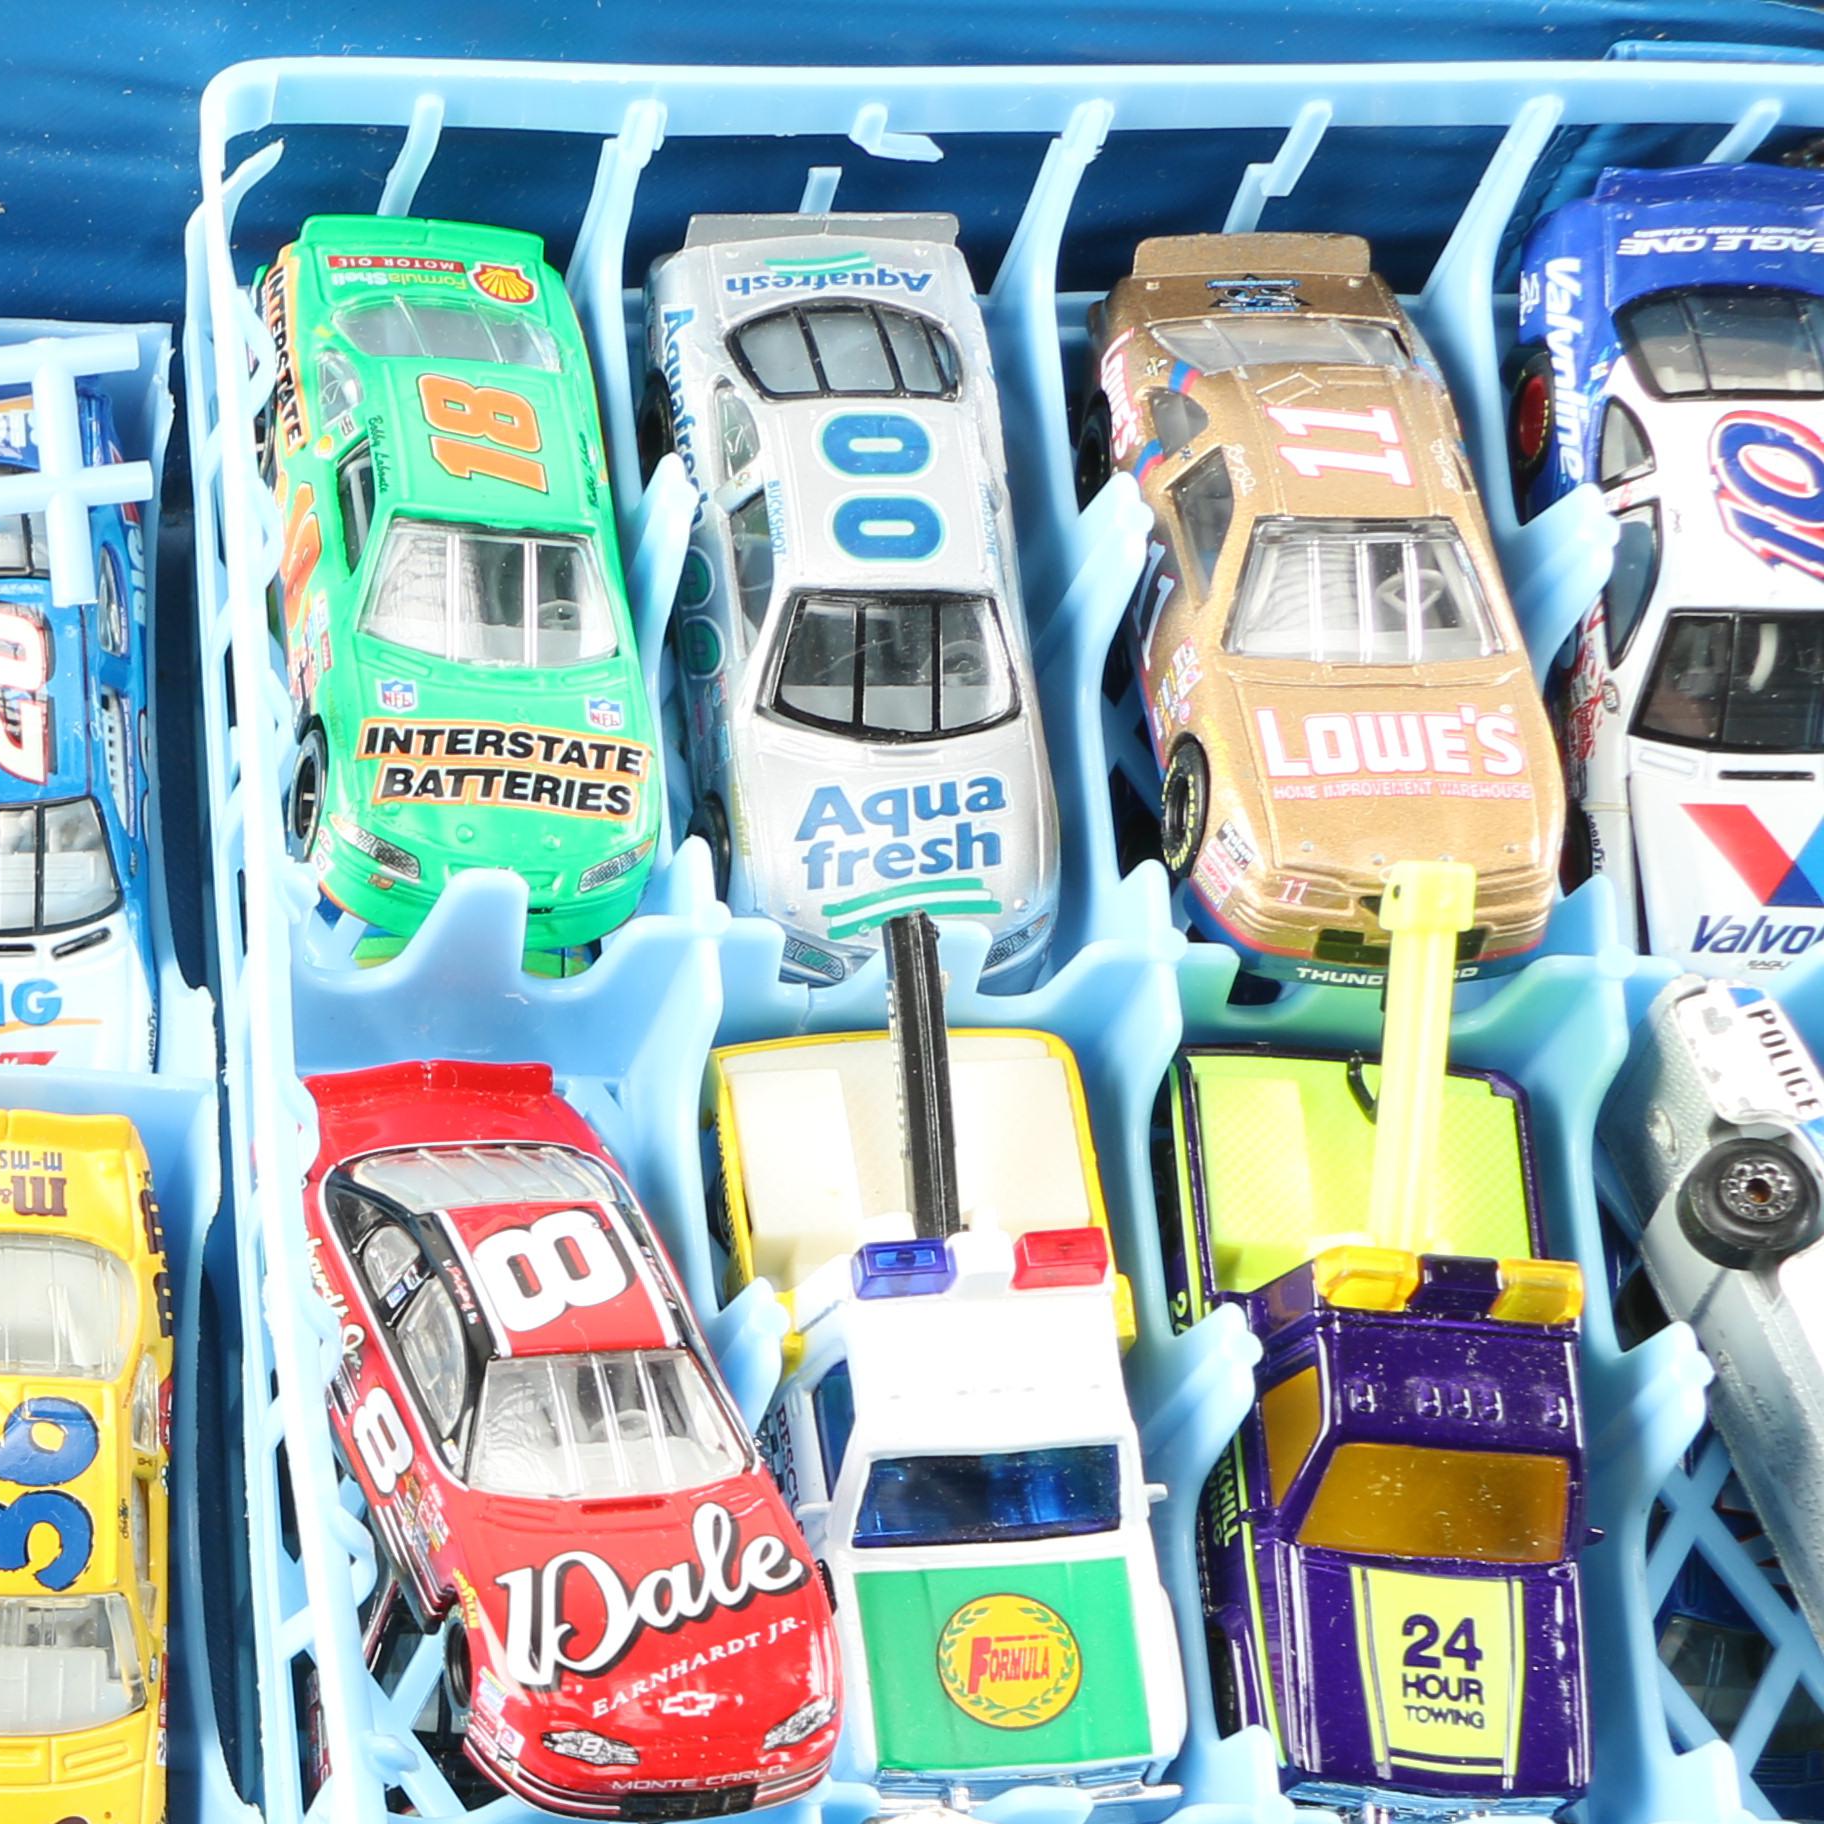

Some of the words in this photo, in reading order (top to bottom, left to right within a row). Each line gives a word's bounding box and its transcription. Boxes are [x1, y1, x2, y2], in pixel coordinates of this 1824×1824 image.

[336, 255, 372, 269] OIL
[381, 256, 456, 271] MOTOR
[1615, 236, 1710, 256] ONE
[725, 267, 935, 298] Aquafresh
[415, 372, 551, 496] 18
[1263, 402, 1415, 488] 11
[815, 408, 947, 564] 00
[767, 479, 787, 556] BUCKSHOT
[382, 690, 414, 707] NFL
[589, 709, 621, 727] NFL
[363, 726, 644, 778] INTERSTATE
[1253, 703, 1525, 779] LOWE'S
[380, 765, 634, 817] BATTERIES
[794, 774, 1007, 843] Aqua
[1272, 783, 1319, 801] HOME
[1322, 779, 1433, 799] IMPROVEMENT
[1438, 779, 1533, 801] WAREHOUSE
[801, 820, 1003, 891] fresh
[1278, 878, 1309, 905] 11
[1691, 914, 1824, 955] Valvo
[1745, 1007, 1824, 1117] POLICE
[470, 1208, 635, 1334] 8
[494, 1501, 807, 1691] Dale
[591, 1631, 761, 1721] EARNHARDT
[765, 1617, 809, 1647] JR.
[966, 1634, 1052, 1695] FORMULA
[1400, 1614, 1484, 1672] 24
[1400, 1673, 1485, 1706] HOUR
[1402, 1704, 1486, 1732] TOWING
[609, 1777, 699, 1792] MONTE
[704, 1766, 787, 1787] CARLO
